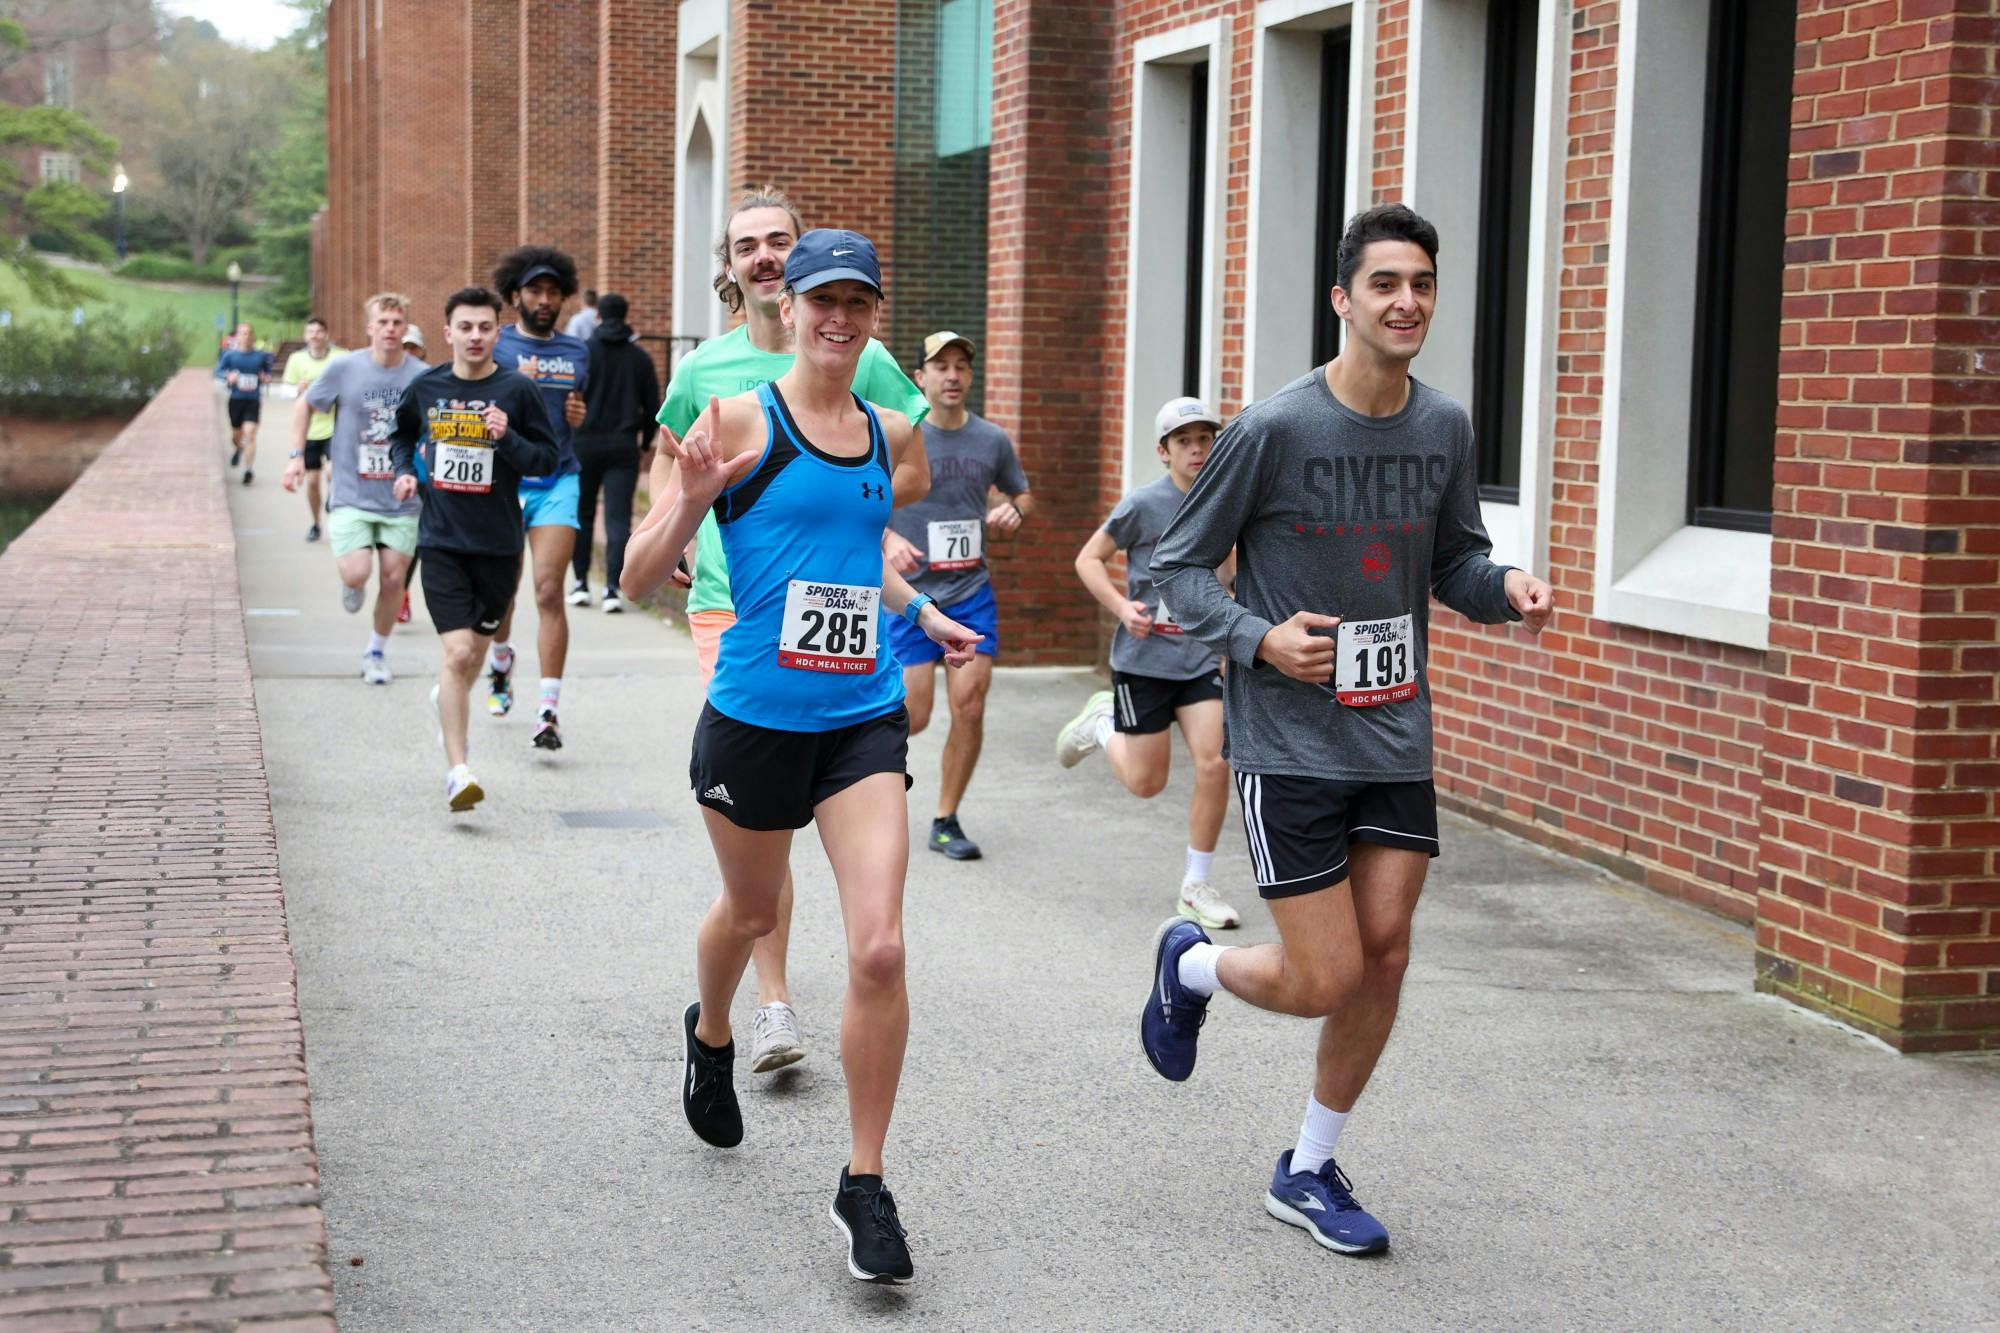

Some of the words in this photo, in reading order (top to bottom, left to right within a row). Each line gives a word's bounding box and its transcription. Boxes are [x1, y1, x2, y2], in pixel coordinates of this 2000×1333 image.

[443, 459, 484, 483] 208
[1303, 455, 1447, 522] SIXERS
[946, 535, 970, 559] 70
[805, 585, 848, 598] SPIDER
[825, 598, 856, 610] DASH
[797, 610, 868, 656] 285
[1354, 622, 1391, 635] SPIDER
[1372, 631, 1397, 644] DASH
[795, 657, 815, 667] HDC
[817, 660, 840, 670] MEAL
[843, 662, 867, 671] TICKET
[1354, 643, 1407, 688] 193
[1351, 695, 1370, 704] HDC
[1371, 693, 1390, 702] MEAL
[1392, 688, 1411, 699] TICKET
[704, 792, 733, 806] adidas
